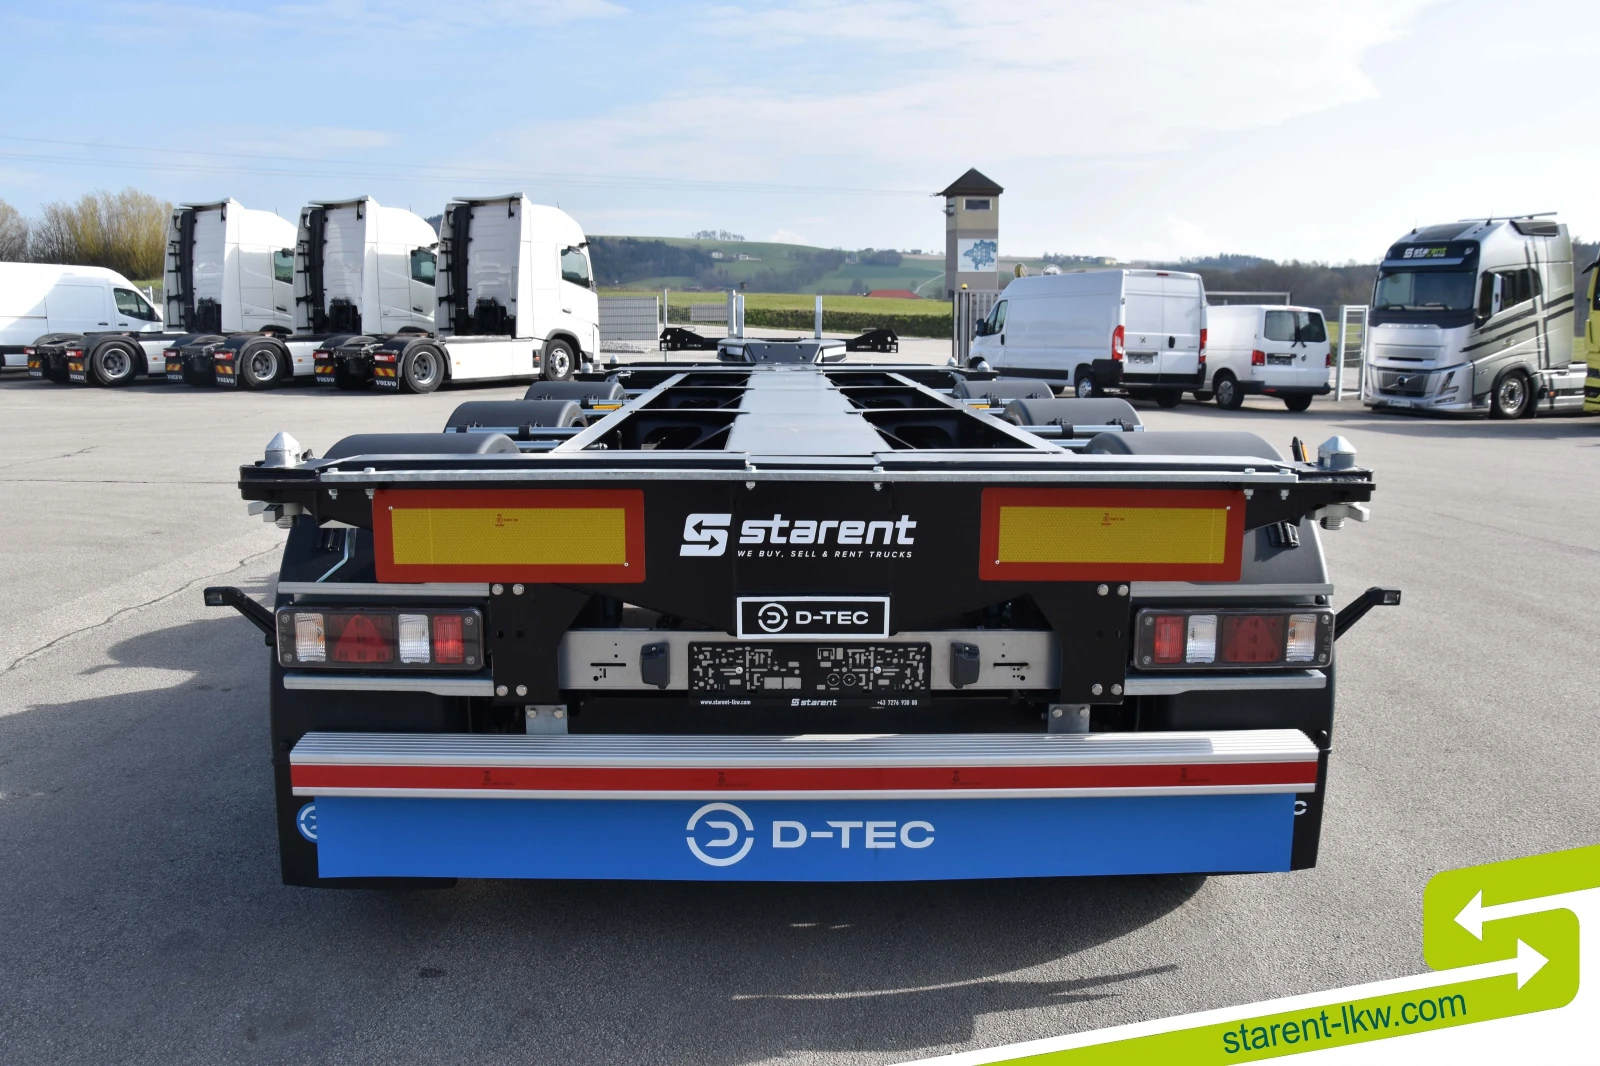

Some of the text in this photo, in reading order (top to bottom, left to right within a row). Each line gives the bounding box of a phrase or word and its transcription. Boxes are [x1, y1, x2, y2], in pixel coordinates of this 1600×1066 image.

[375, 379, 396, 388] VOLVO
[738, 513, 917, 546] starent
[737, 550, 913, 559] WE BUY, SELL & RENT TRUCKS
[795, 610, 869, 626] D-TEC
[800, 698, 838, 706] starent
[772, 820, 936, 850] D-TEC
